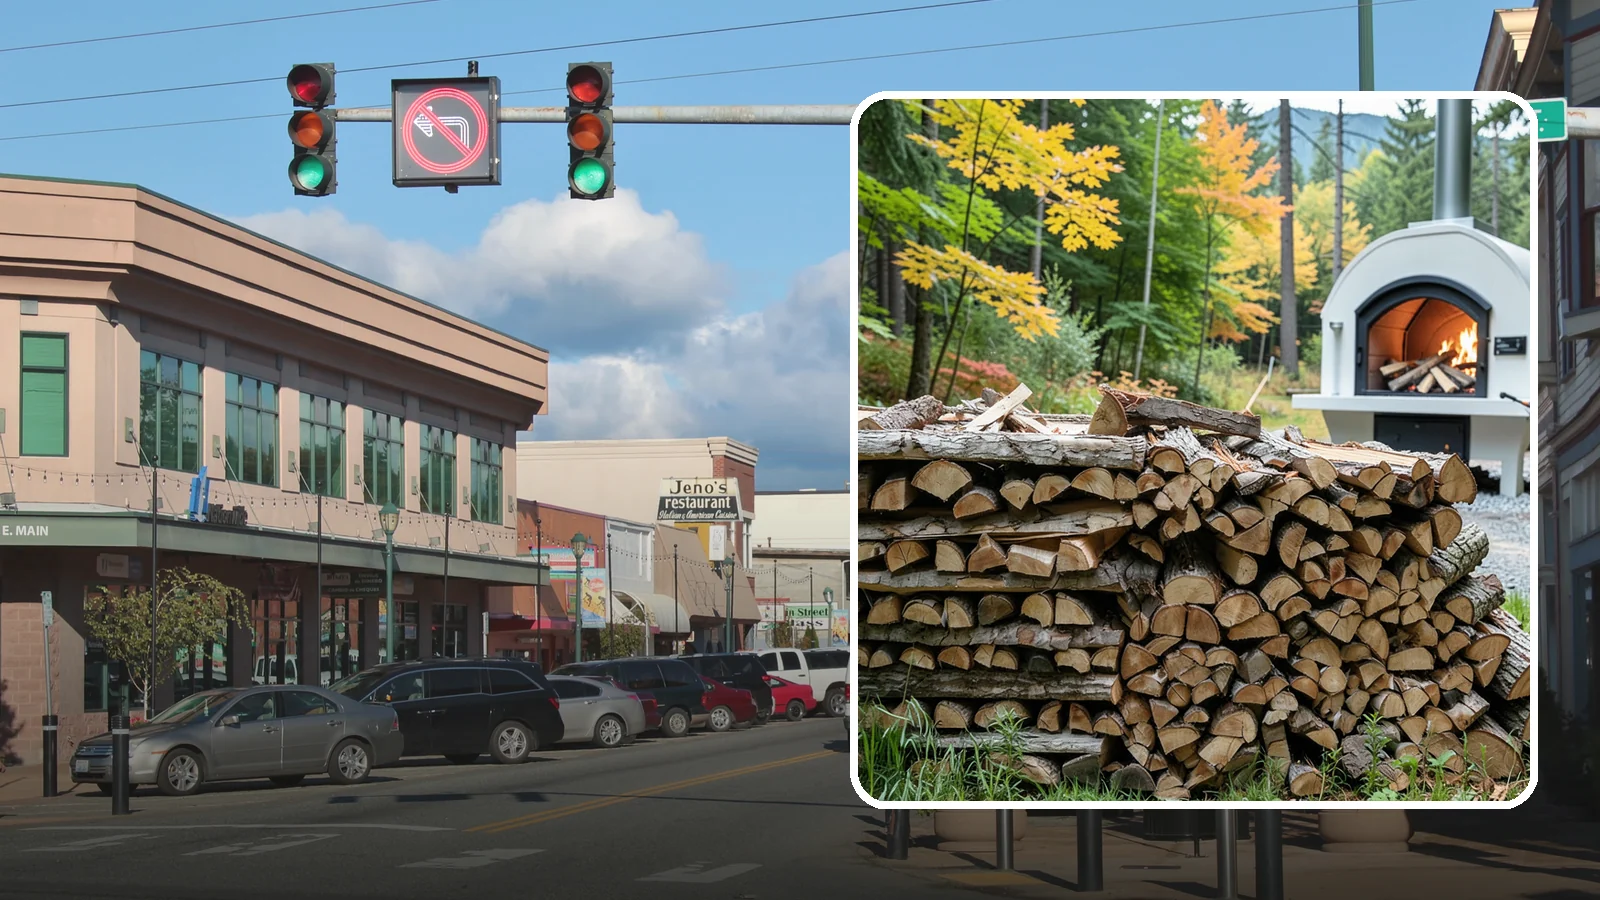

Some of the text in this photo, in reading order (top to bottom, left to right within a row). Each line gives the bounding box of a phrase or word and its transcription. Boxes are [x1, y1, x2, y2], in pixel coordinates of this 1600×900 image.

[669, 480, 728, 495] Jeno's
[665, 496, 731, 509] restaurant
[658, 510, 682, 520] Italian
[686, 509, 714, 519] American
[715, 509, 737, 519] Cuisine
[2, 525, 49, 536] E. MAIN
[797, 607, 828, 616] Street
